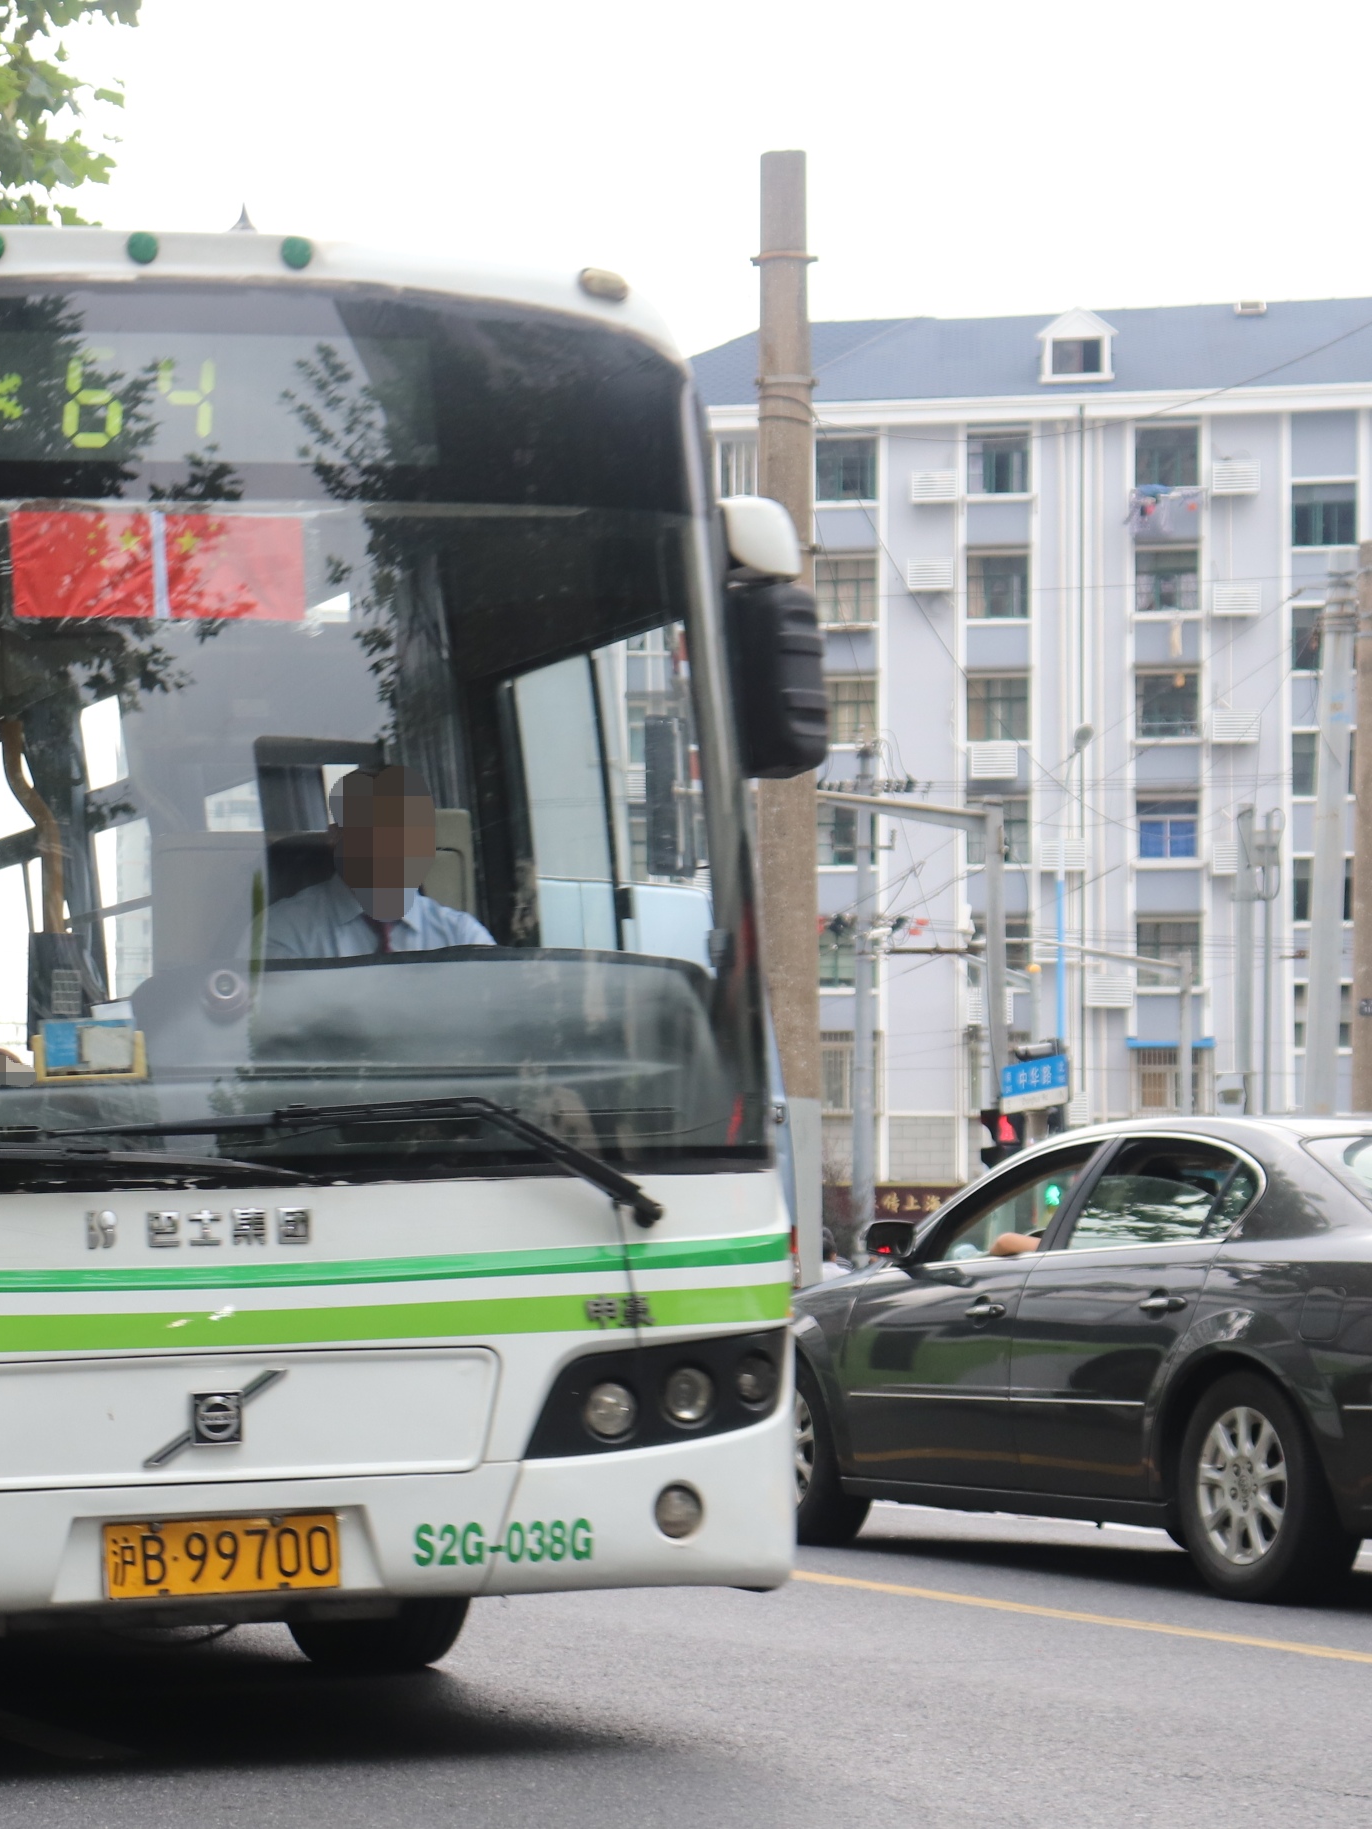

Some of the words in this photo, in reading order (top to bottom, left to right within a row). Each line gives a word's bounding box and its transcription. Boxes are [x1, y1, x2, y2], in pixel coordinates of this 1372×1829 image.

[62, 346, 216, 448] 64
[1018, 1064, 1052, 1089] 中华路
[413, 1517, 593, 1567] S2G-038G
